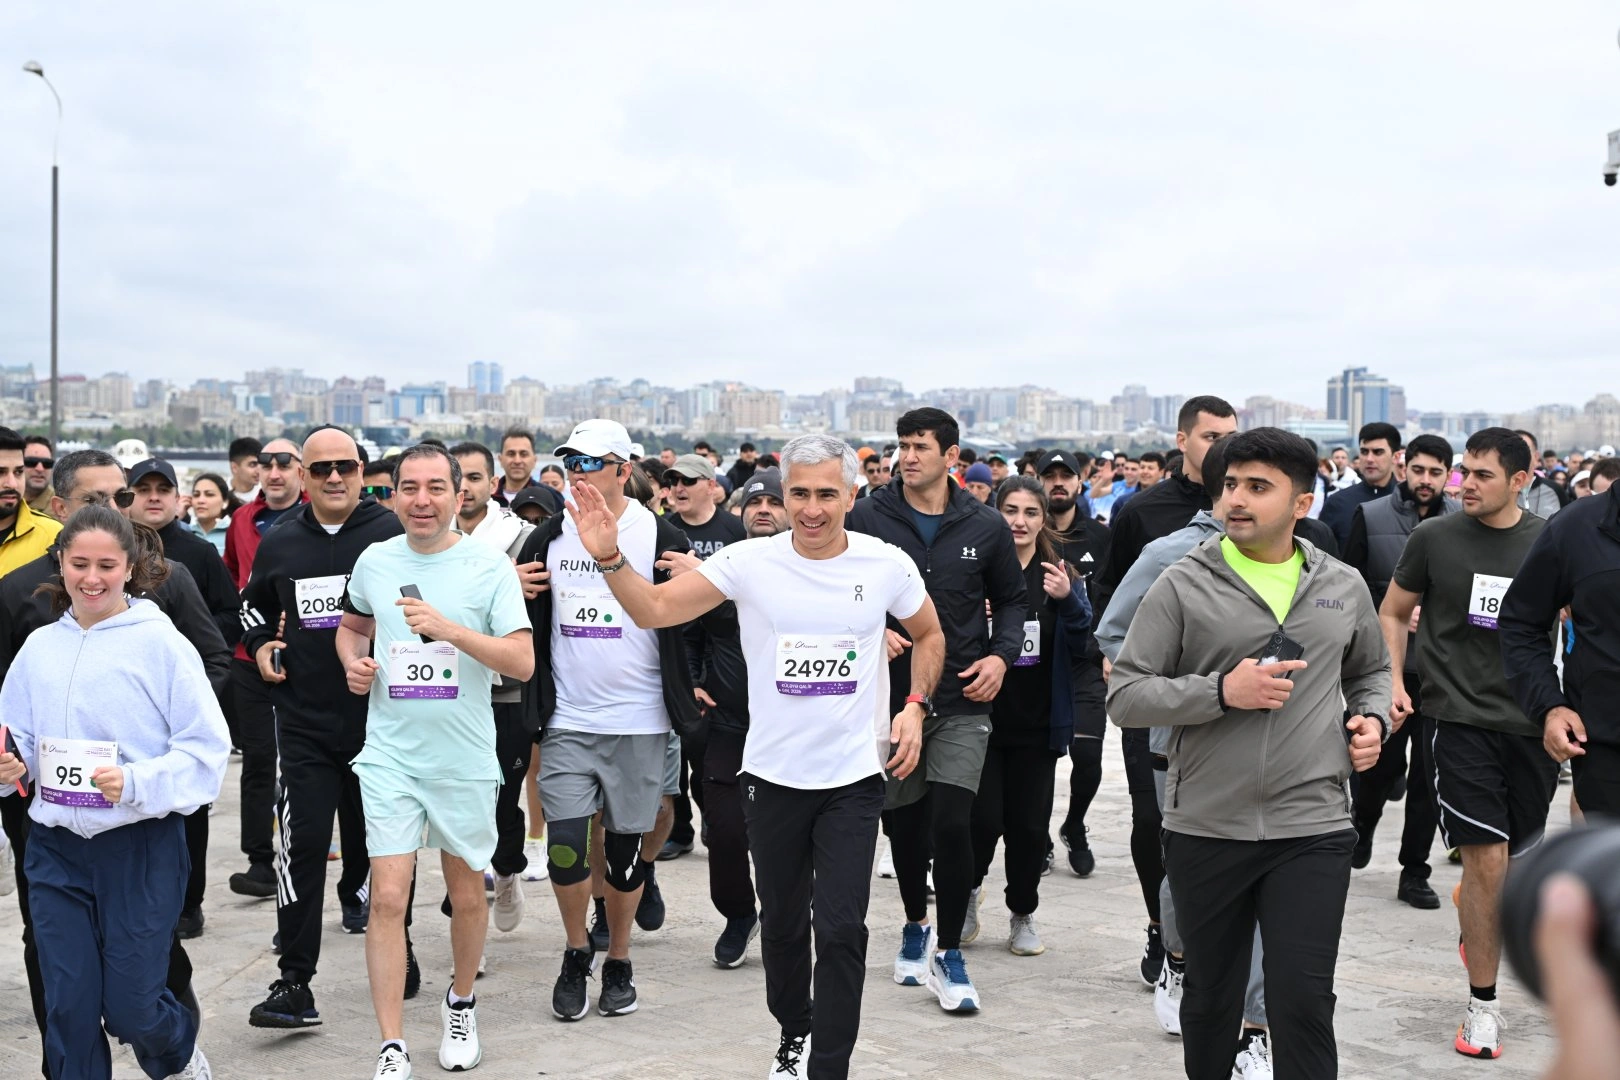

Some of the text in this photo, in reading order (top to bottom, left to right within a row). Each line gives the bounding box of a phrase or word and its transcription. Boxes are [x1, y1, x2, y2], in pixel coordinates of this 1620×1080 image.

[1315, 598, 1344, 611] RUN
[1479, 596, 1499, 613] 18
[575, 607, 598, 623] 49
[406, 663, 434, 682] 30
[784, 658, 851, 678] 24976
[56, 765, 82, 786] 95
